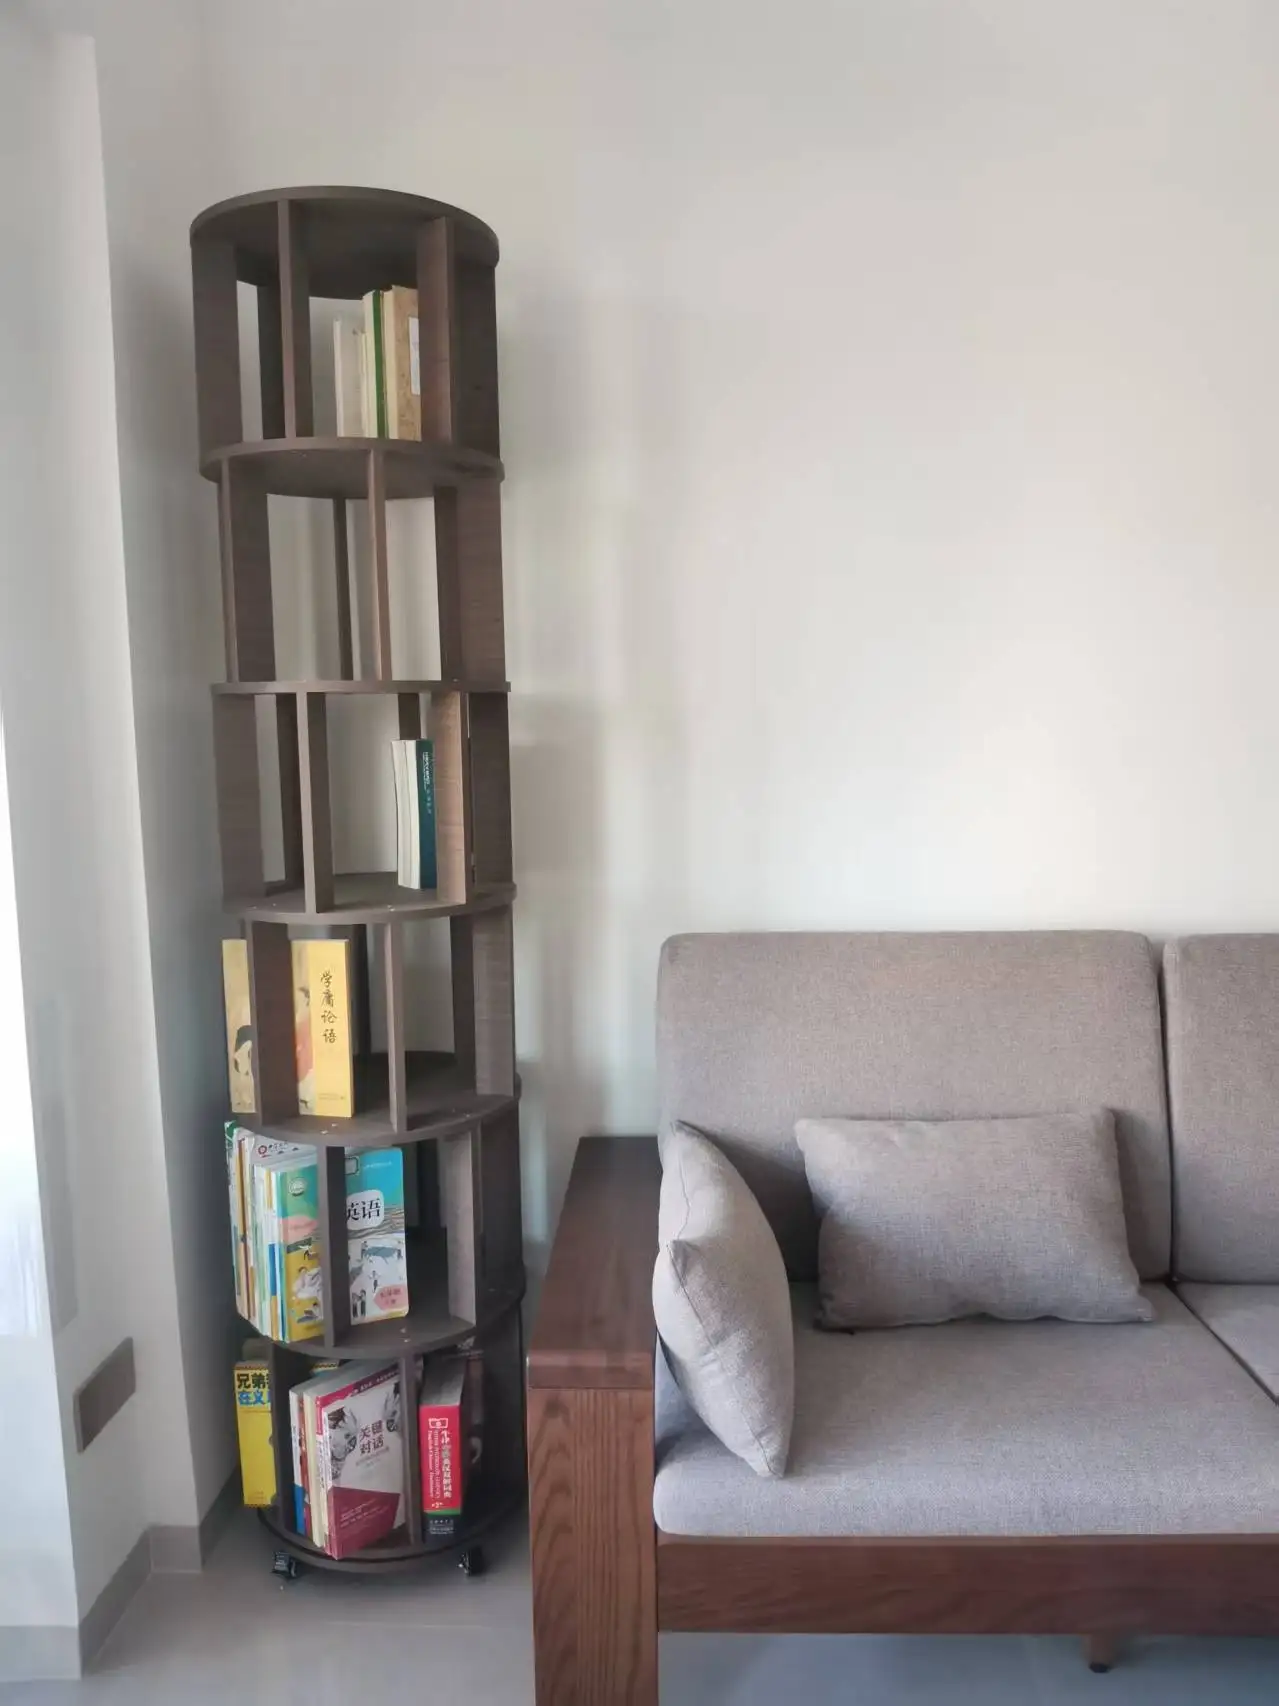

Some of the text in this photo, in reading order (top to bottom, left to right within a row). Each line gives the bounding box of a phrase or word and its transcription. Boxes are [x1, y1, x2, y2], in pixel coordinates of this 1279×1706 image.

[320, 969, 338, 1044] 学庸论语
[347, 1198, 381, 1221] 英语
[237, 1372, 269, 1389] 兄弟
[359, 1420, 384, 1440] 关键
[360, 1435, 385, 1454] 对话
